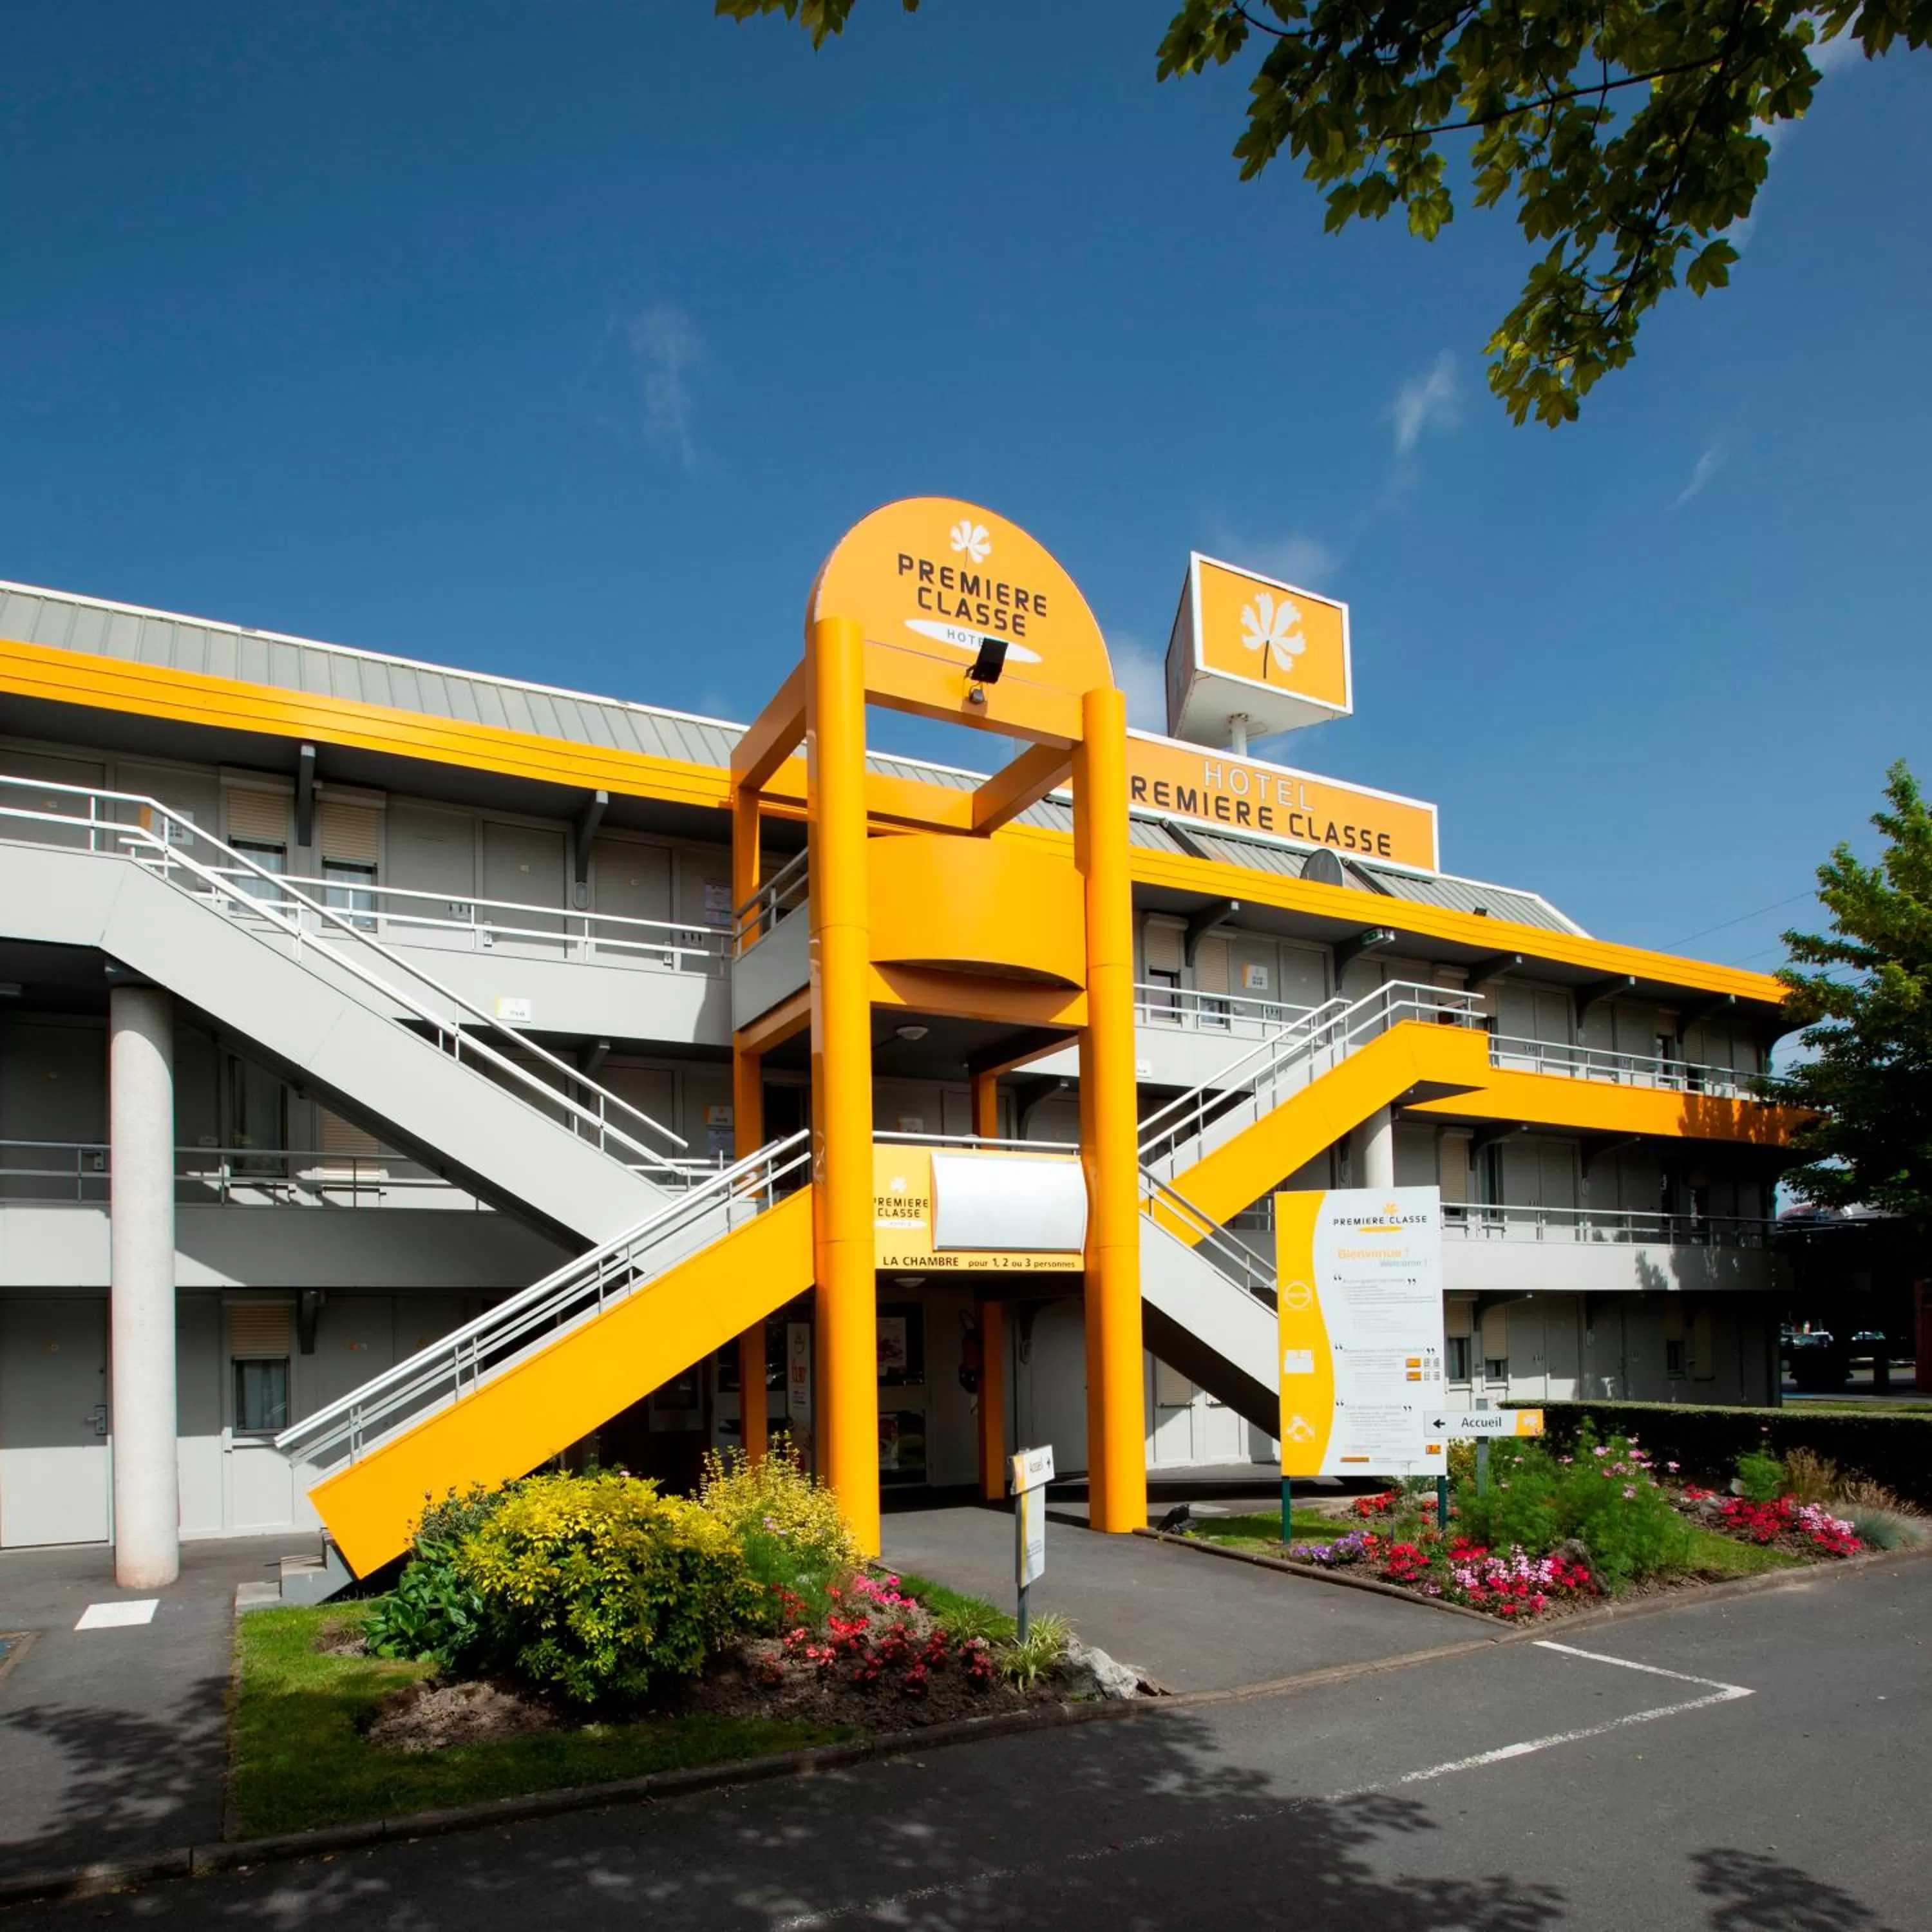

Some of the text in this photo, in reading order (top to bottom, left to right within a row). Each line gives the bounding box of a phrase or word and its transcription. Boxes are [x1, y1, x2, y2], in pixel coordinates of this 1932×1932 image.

[898, 553, 1047, 618] PREMIERE
[917, 587, 1027, 637] CLASSE
[947, 628, 985, 647] HOTE
[1204, 761, 1314, 812] HOTEL
[1131, 775, 1274, 831] REMIERE
[1289, 813, 1392, 857] CLASSE
[873, 1197, 928, 1208] REMIERE
[878, 1208, 920, 1218] CLASSE
[1333, 1215, 1427, 1226] PREMIERE CLASSE
[1338, 1248, 1402, 1258] Bienvenue
[883, 1256, 898, 1265] LA
[903, 1256, 959, 1267] CHAMBRE
[968, 1260, 988, 1268] pour
[992, 1258, 999, 1267] 1,
[1002, 1258, 1009, 1267] 2
[1025, 1258, 1031, 1267] 3
[1034, 1260, 1075, 1269] personnes
[1461, 1416, 1502, 1428] Accueil
